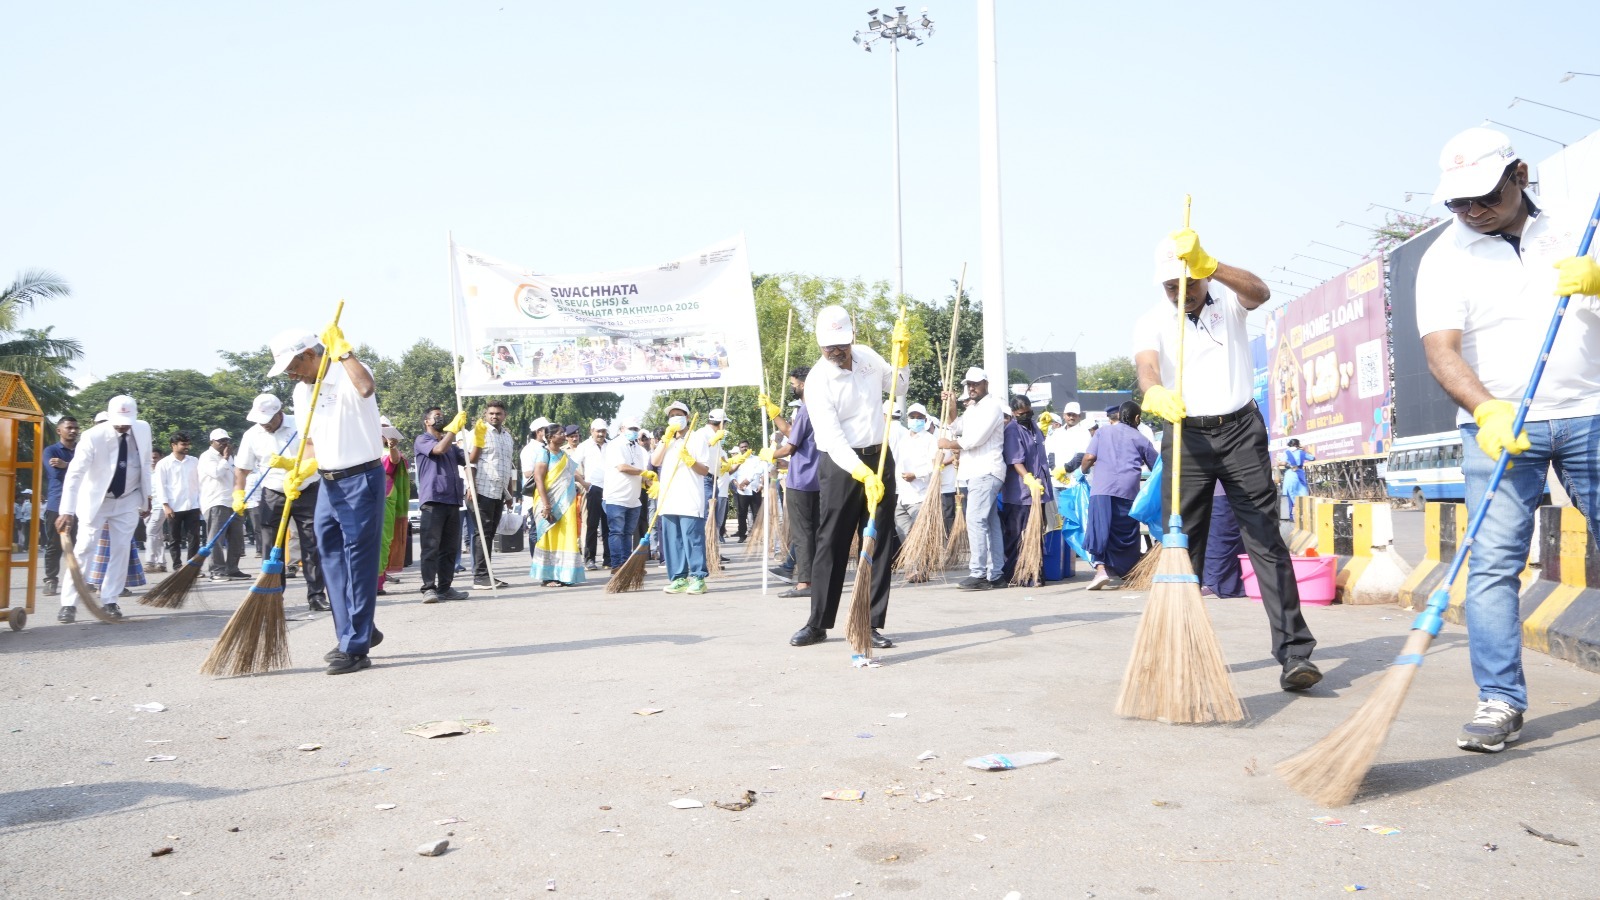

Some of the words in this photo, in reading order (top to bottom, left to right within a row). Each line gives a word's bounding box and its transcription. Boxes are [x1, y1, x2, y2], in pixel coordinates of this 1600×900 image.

[550, 283, 639, 298] SWACHHATA
[557, 304, 614, 318] SWACHHATA
[616, 303, 673, 316] PAKHWADA
[675, 301, 700, 312] 2026
[564, 299, 589, 307] SEVA
[592, 297, 619, 308] (SHS)
[621, 297, 629, 305] &
[1302, 313, 1331, 342] HOME
[1331, 298, 1364, 328] LOAN
